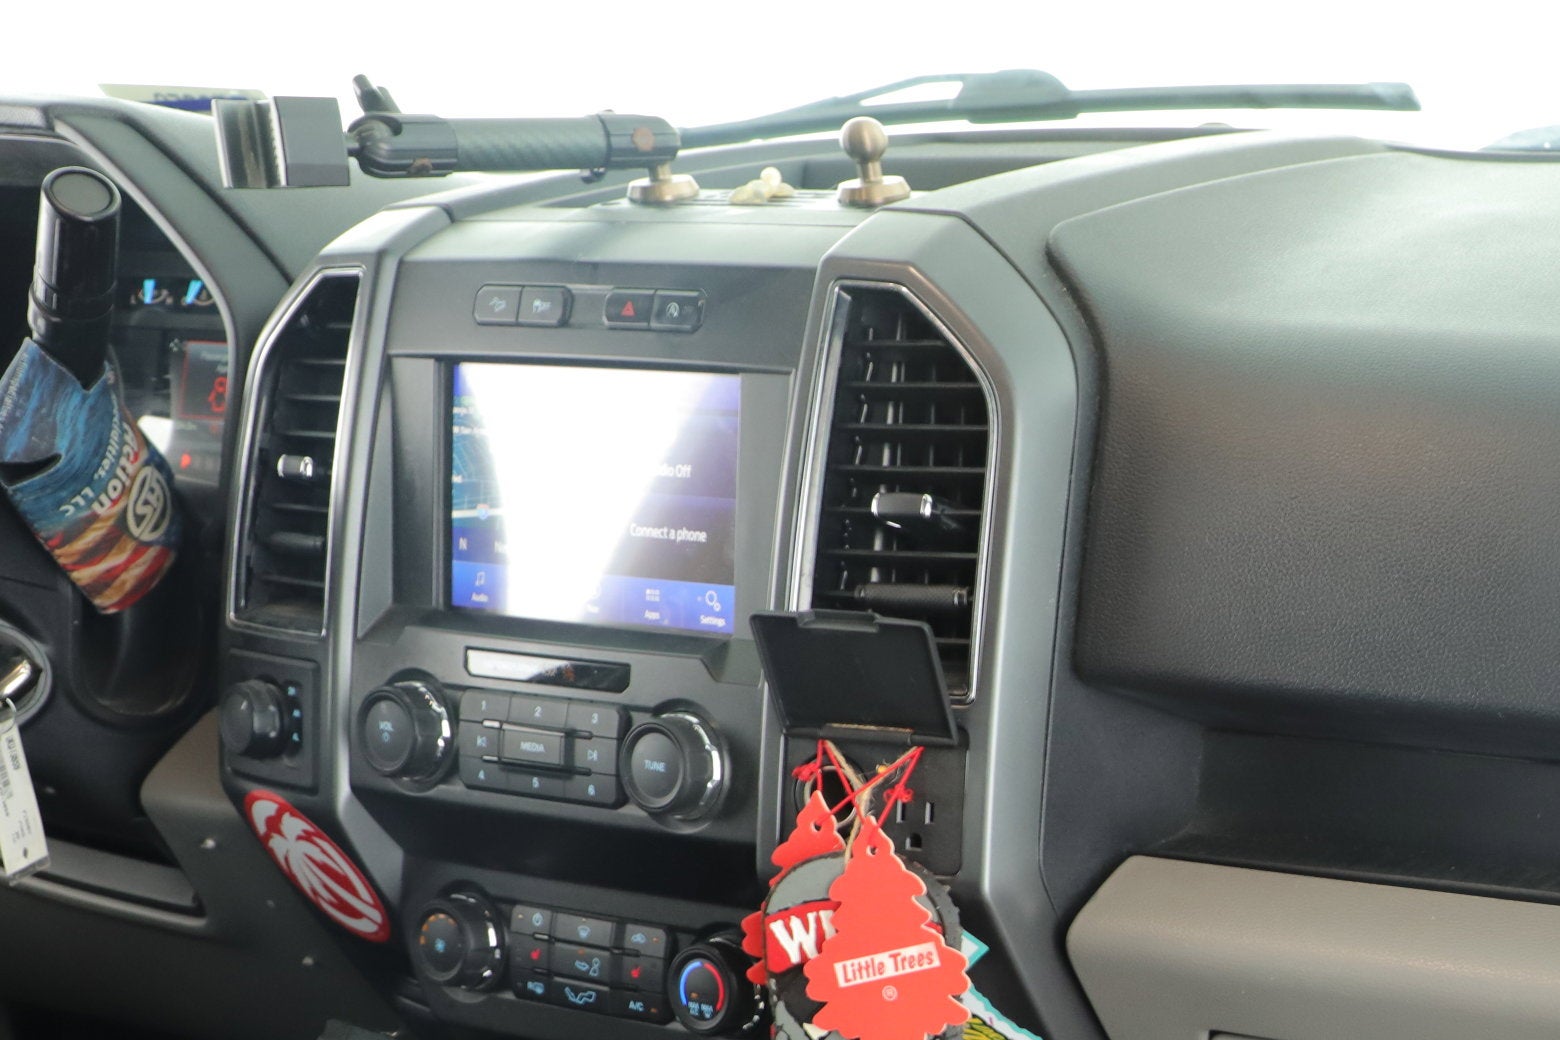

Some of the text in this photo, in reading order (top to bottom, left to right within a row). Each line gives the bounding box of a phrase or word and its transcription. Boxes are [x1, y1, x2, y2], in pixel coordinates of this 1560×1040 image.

[91, 421, 139, 515] Action
[675, 463, 692, 479] Off
[58, 486, 96, 518] LLC
[629, 522, 668, 541] Connect
[676, 527, 708, 544] phone
[700, 614, 727, 628] Settings
[533, 705, 542, 718] 2
[591, 713, 599, 724] 3
[520, 741, 546, 753] MEDIA
[643, 758, 667, 774] TUNE
[477, 769, 485, 780] 4
[841, 950, 936, 984] Little Trees
[629, 1000, 644, 1012] A/C
